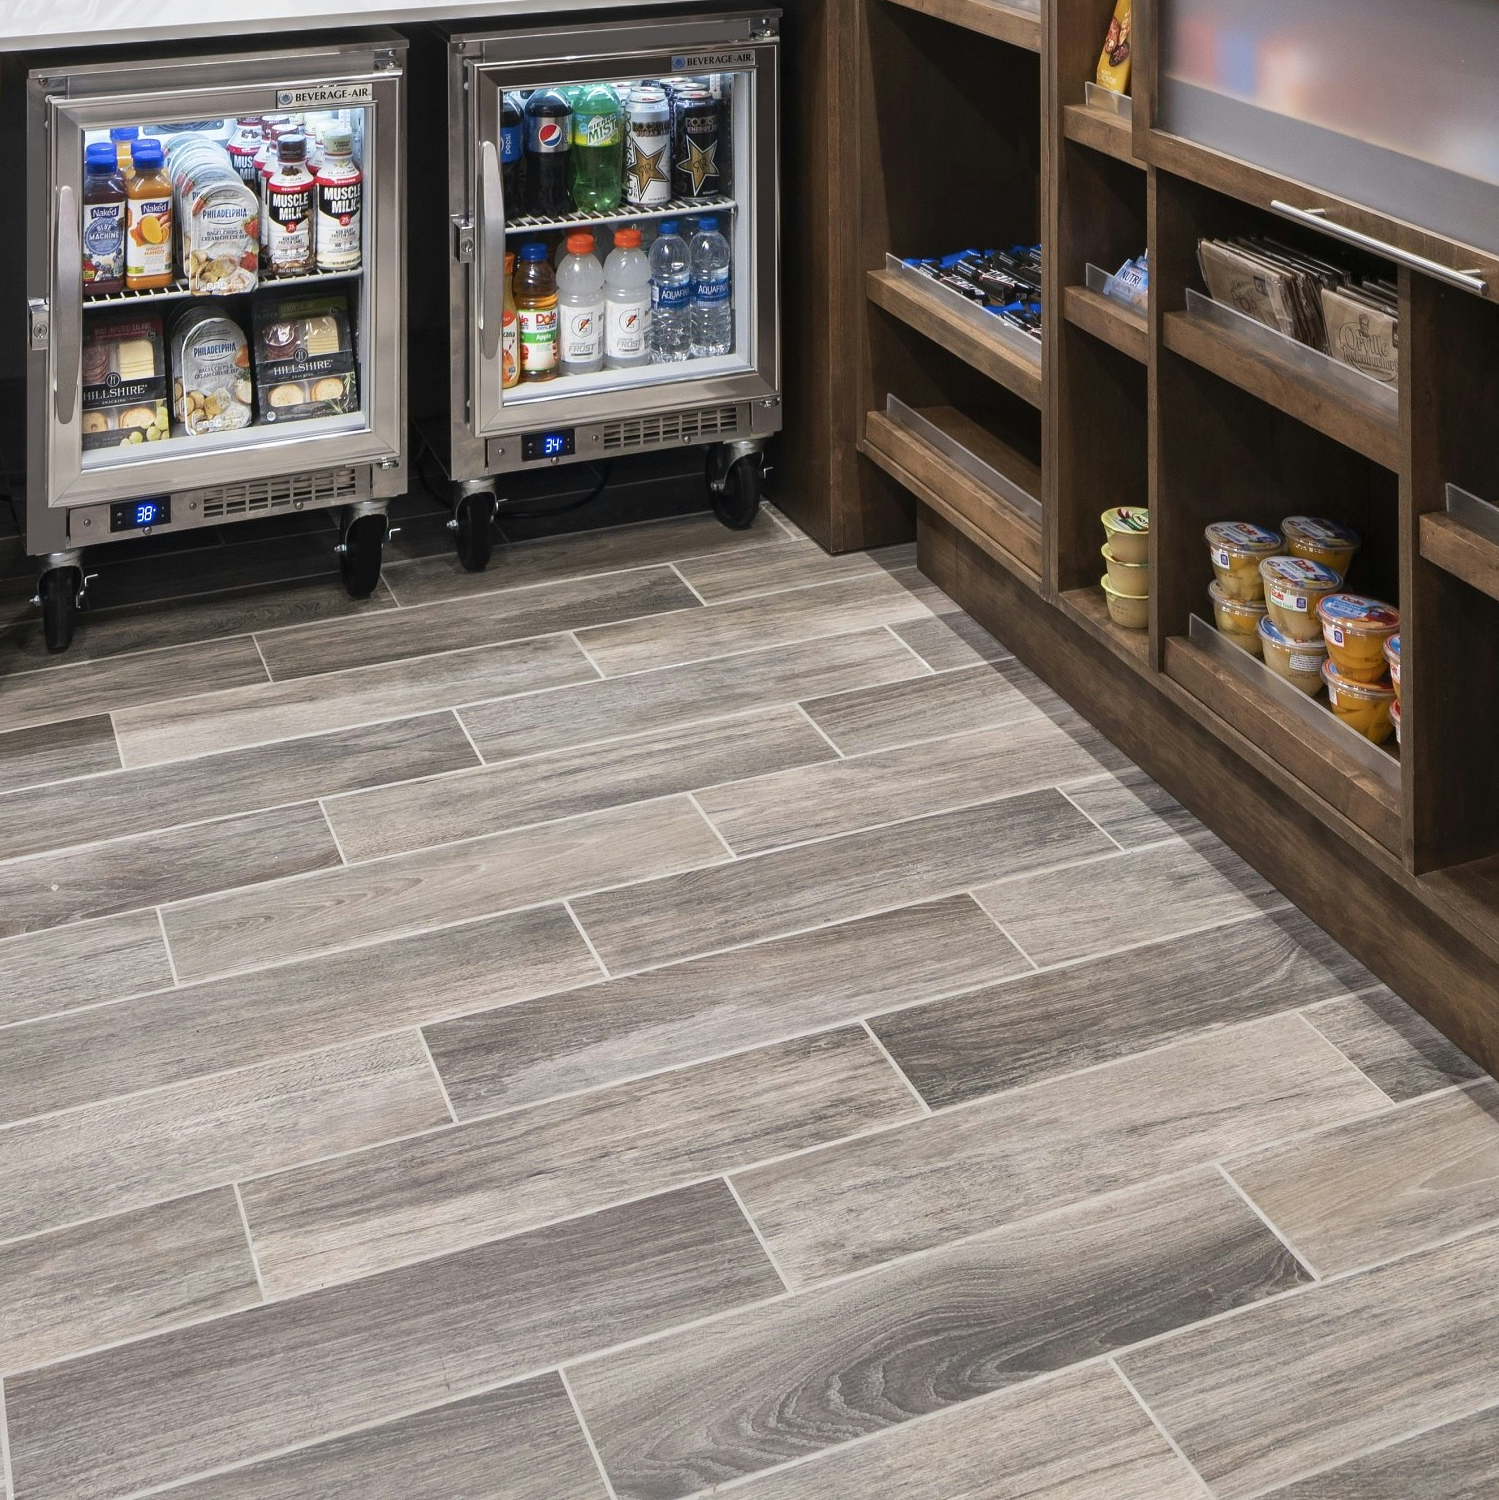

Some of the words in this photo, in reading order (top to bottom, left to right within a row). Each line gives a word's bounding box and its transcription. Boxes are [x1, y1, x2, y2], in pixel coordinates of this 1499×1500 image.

[686, 53, 753, 68] BEVERAGE-AIR
[295, 87, 369, 102] BEVERAGE-AIR
[588, 112, 617, 132] SIERRA
[587, 121, 619, 146] MIST
[504, 133, 512, 155] pepsi
[272, 192, 309, 208] MUSCLE
[324, 185, 361, 200] MUSCLE
[202, 207, 248, 220] PHILADELPHIA
[279, 207, 302, 221] MILK
[331, 199, 357, 214] MILK
[89, 231, 120, 241] MACHINE
[535, 310, 557, 325] Dole
[535, 333, 552, 342] Apple
[1339, 321, 1390, 357] Orville
[193, 342, 237, 358] PHILADELPHIA
[273, 359, 332, 376] HILLSHIRE
[83, 383, 146, 401] HILLSHIRE
[1235, 523, 1258, 536] Dole
[1294, 559, 1316, 573] Dole
[1271, 588, 1285, 601] Dole
[1341, 595, 1365, 607] Dole
